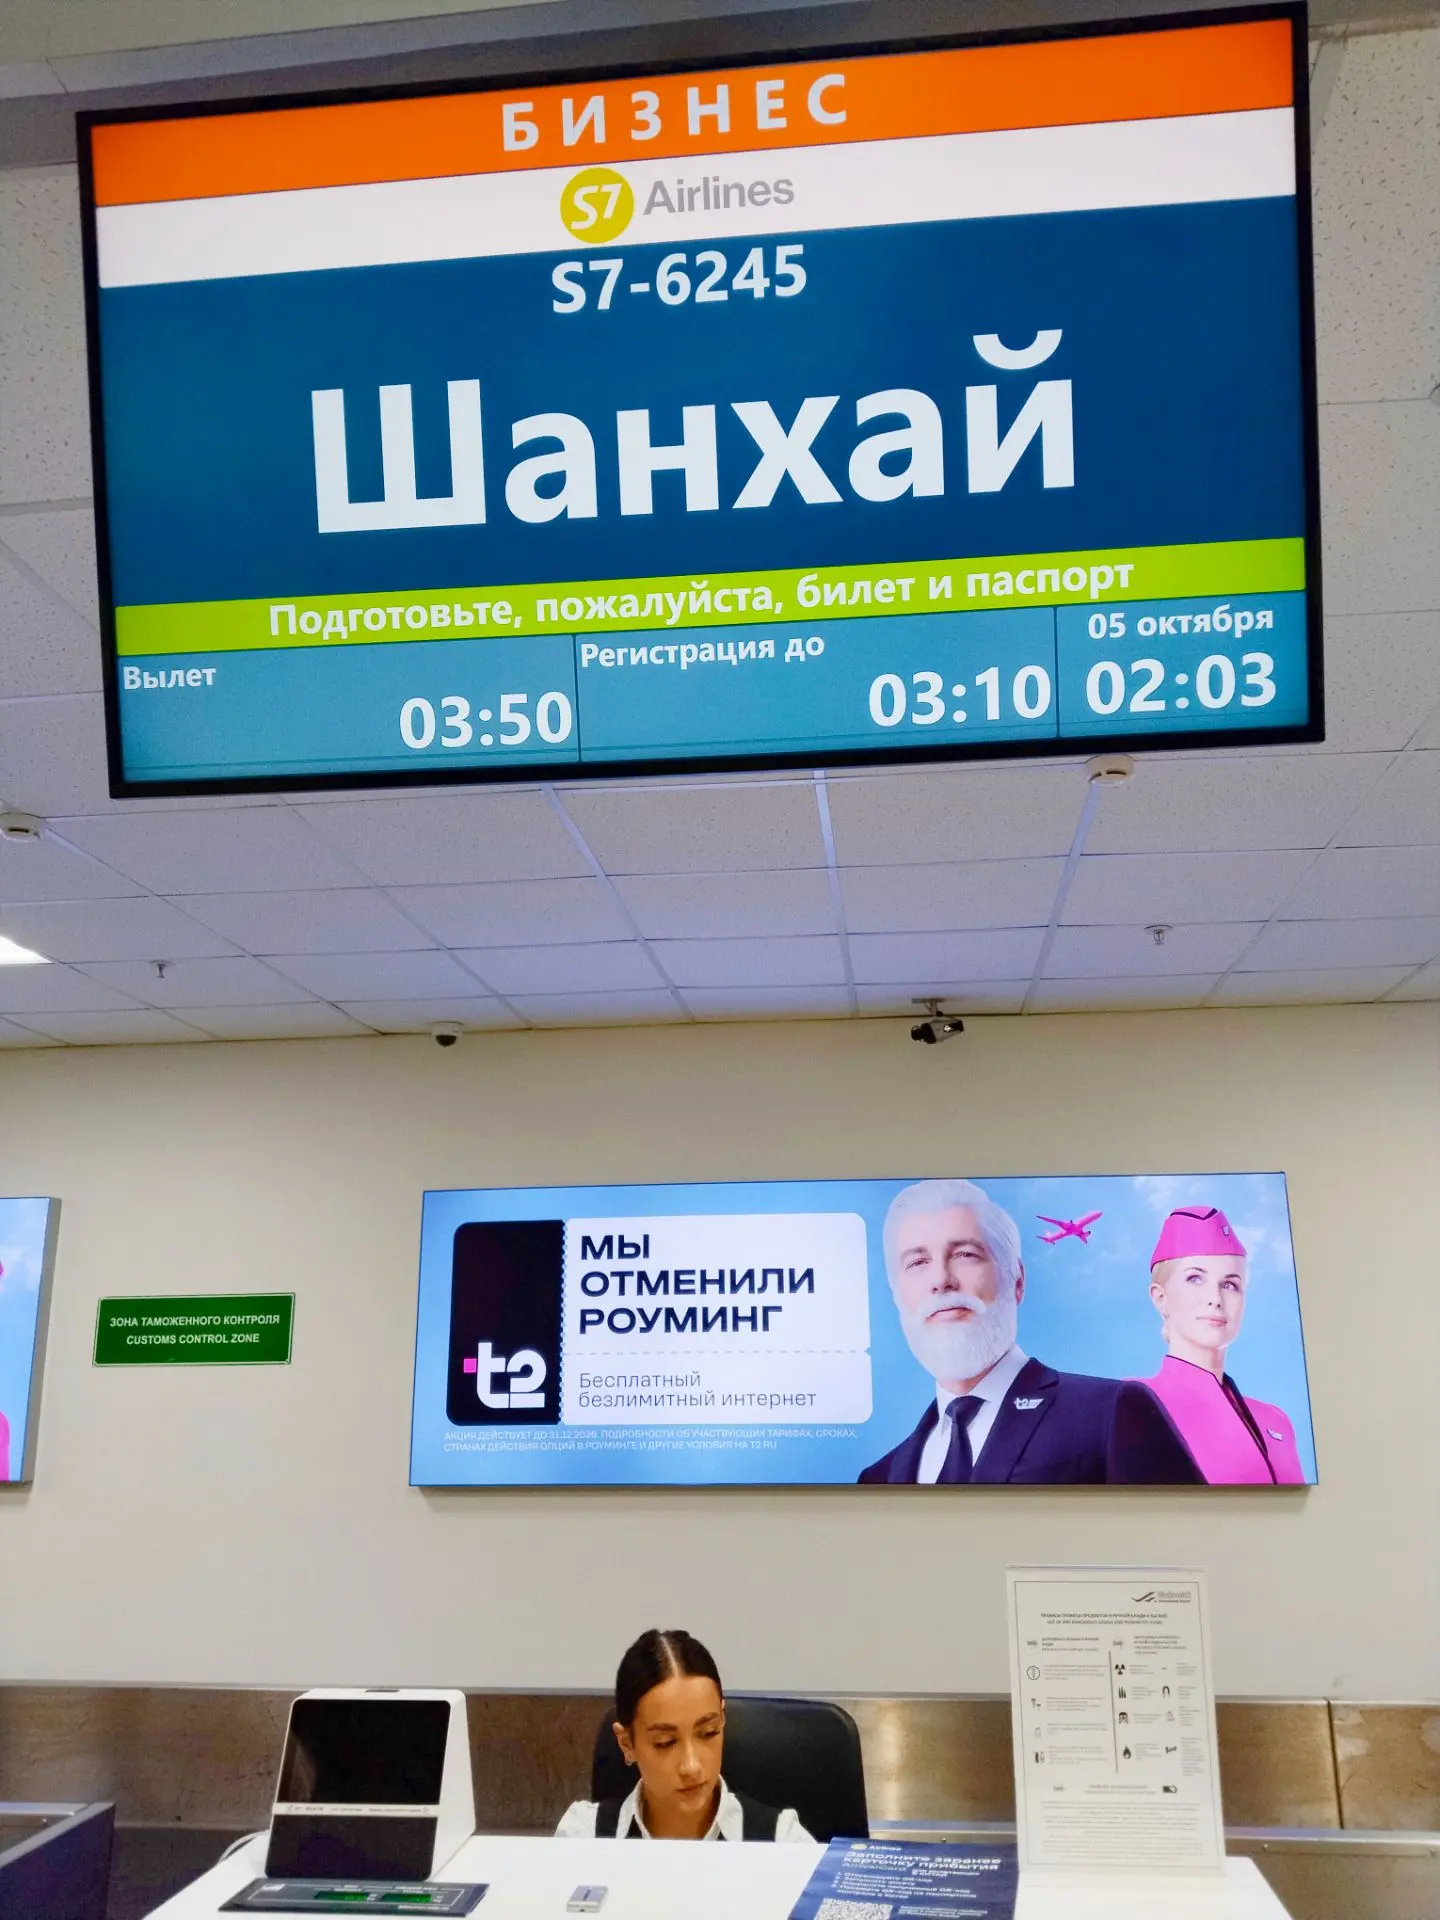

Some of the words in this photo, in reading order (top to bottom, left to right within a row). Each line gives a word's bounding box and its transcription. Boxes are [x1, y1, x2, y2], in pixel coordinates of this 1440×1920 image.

[502, 74, 847, 151] БИЗНЕС
[571, 183, 622, 230] S7
[643, 175, 794, 215] Airlines
[552, 244, 807, 313] S7-6245
[311, 329, 1075, 534] Шанхай
[269, 596, 523, 639] Подготовьте,
[536, 580, 783, 624] пожалуйста,
[797, 573, 915, 609] билет
[929, 576, 952, 599] и
[967, 563, 1134, 600] паспорт
[1088, 613, 1125, 640] 05
[1137, 604, 1274, 643] октября
[581, 639, 775, 670] Регистрация
[785, 636, 825, 662] до
[123, 666, 216, 690] Вылет
[868, 664, 1051, 726] 03:10
[1086, 651, 1277, 716] 02:03
[400, 691, 572, 750] 03:50
[581, 1234, 650, 1260] МЫ
[581, 1267, 815, 1297] ОТМЕНИЛИ
[110, 1317, 138, 1328] ЗОНА
[141, 1315, 221, 1327] ТАМОЖЕННОГО
[223, 1314, 280, 1325] КОНТРОЛЯ
[126, 1335, 176, 1345] CUSTOMS
[179, 1334, 228, 1344] CONTROL
[230, 1333, 260, 1343] ZONE
[580, 1305, 782, 1334] РОУМИНГ
[464, 1342, 547, 1409] t2
[579, 1371, 701, 1389] Бесплатный
[578, 1389, 716, 1408] безлимитный
[722, 1392, 817, 1410] интернет
